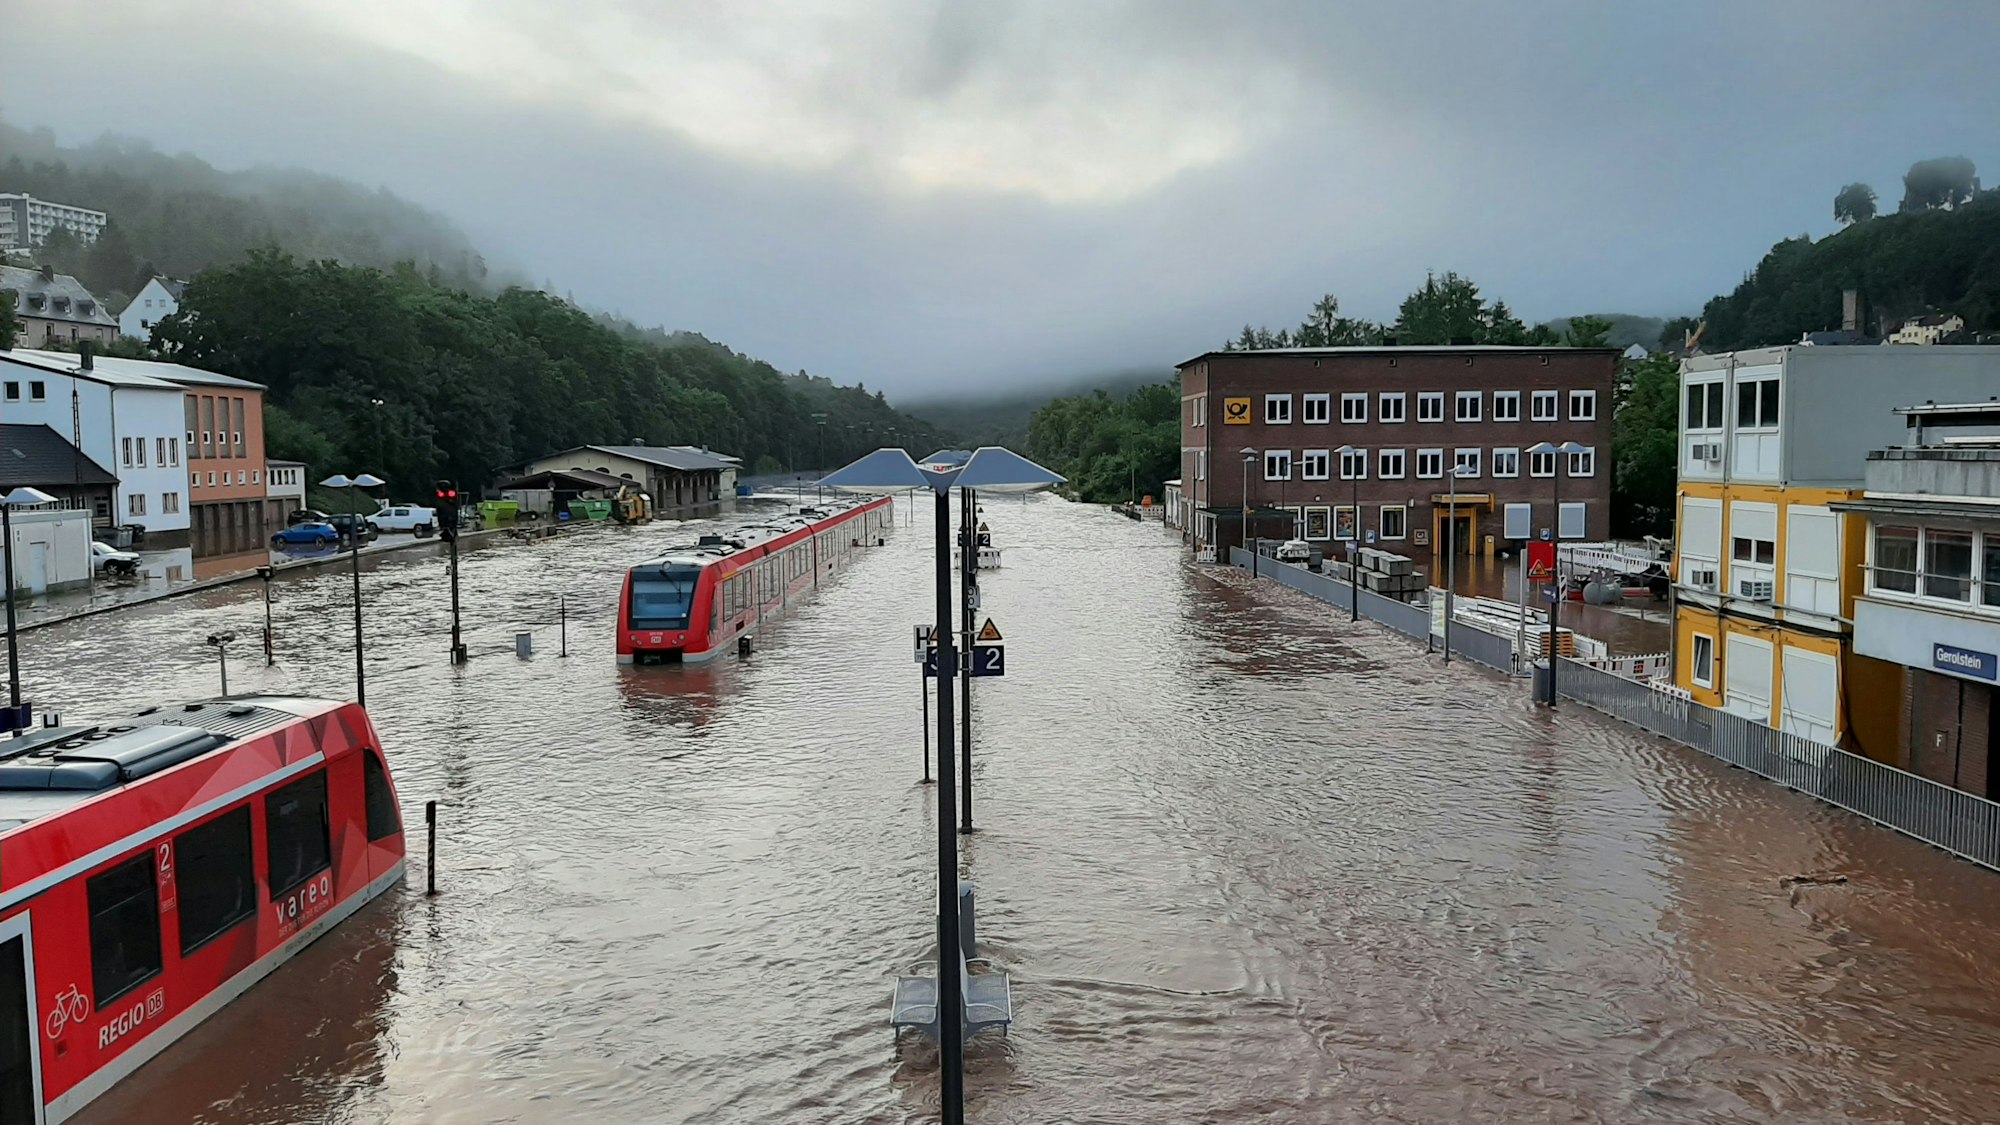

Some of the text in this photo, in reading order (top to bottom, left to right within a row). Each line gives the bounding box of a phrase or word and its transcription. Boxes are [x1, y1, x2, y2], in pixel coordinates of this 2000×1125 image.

[982, 534, 989, 544] 2
[916, 627, 930, 650] H
[986, 648, 1000, 670] 2
[1936, 648, 1982, 670] Gerolstein
[1936, 734, 1942, 747] F
[160, 844, 170, 872] 2
[276, 876, 328, 924] vareo
[99, 1002, 144, 1050] REGIO
